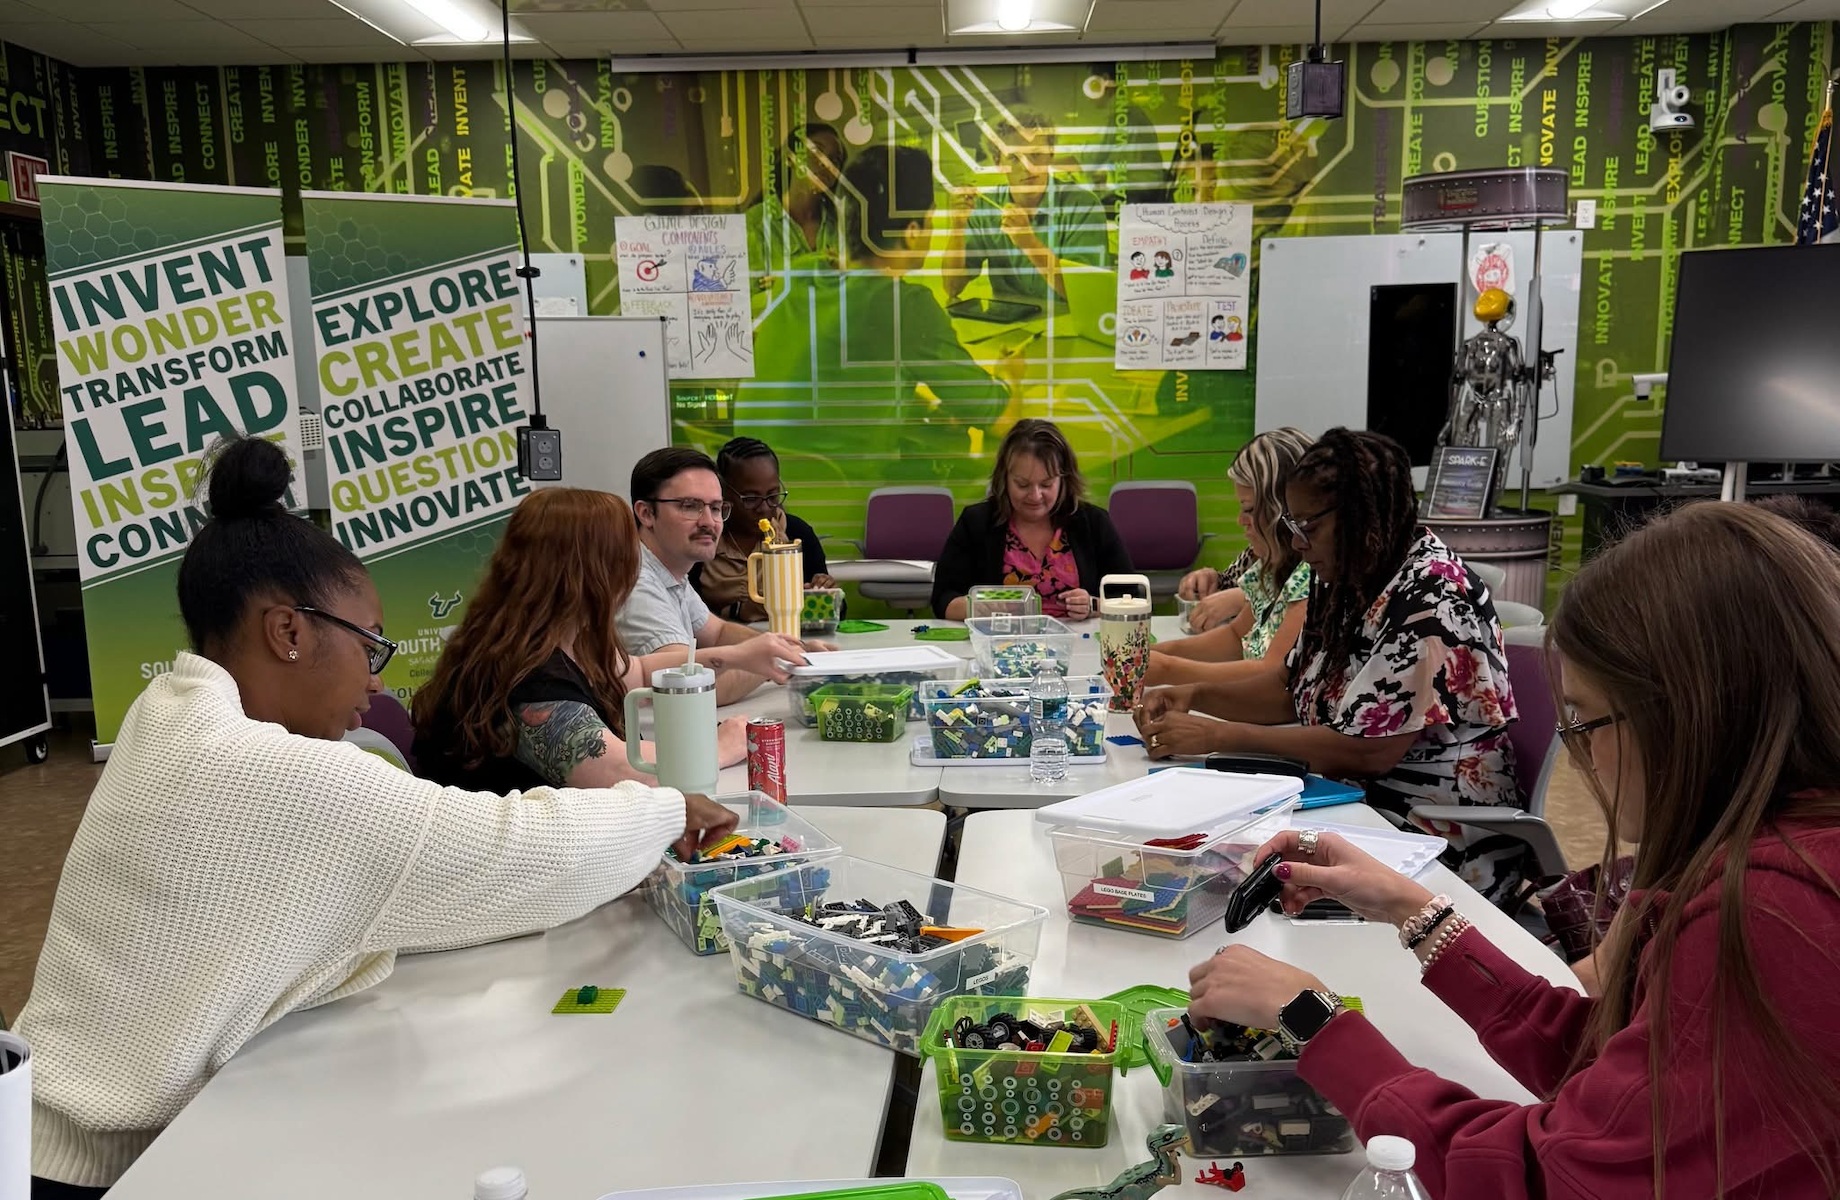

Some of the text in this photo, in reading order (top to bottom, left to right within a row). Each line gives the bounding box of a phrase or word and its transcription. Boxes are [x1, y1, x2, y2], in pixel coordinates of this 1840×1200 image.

[258, 66, 275, 123] INVEN
[291, 64, 306, 107] INVE
[1475, 39, 1493, 138] QUESTION
[1509, 57, 1525, 133] INSPIRE
[1675, 36, 1690, 86] NVEN
[1772, 23, 1790, 106] NOVATE
[1806, 24, 1824, 104] CREATE
[98, 85, 119, 159] INSPIRE
[163, 79, 181, 154] INSPIRE
[195, 81, 216, 170] CONNECT
[226, 66, 245, 143] CREATE
[356, 81, 377, 192] RANSFORM
[453, 66, 474, 197] VATE INVENT
[1540, 89, 1556, 167] NOVATE
[1572, 51, 1592, 187] LEAD INSPIRE
[1635, 37, 1655, 175] LEAD CREATE
[1409, 113, 1423, 175] REATE
[573, 158, 588, 243] WONDER
[689, 215, 727, 231] DESIGN
[1142, 207, 1165, 216] Human
[1203, 206, 1227, 219] Design
[1602, 156, 1619, 231] INSPIRE
[1631, 194, 1647, 261] INVENT
[1698, 187, 1709, 238] LEAD
[1729, 186, 1745, 246] NNECT
[662, 231, 718, 245] COMPONENTS
[53, 237, 273, 332] INVENT
[315, 260, 520, 347] EXPLORE
[1215, 301, 1237, 311] TEST
[1595, 249, 1613, 344] INNOVATE
[59, 290, 284, 376] WONDER
[62, 331, 289, 413] TRANSFORM
[319, 303, 524, 397] CREATE
[324, 351, 525, 429] COLLABORATE
[1176, 371, 1188, 402] INV
[71, 371, 288, 482] LEAD
[328, 382, 527, 475] INSPIRE
[331, 430, 519, 513] QUESTION
[336, 465, 532, 551] INNOVATE
[394, 637, 441, 655] OUTH
[973, 975, 989, 984] LEGOS
